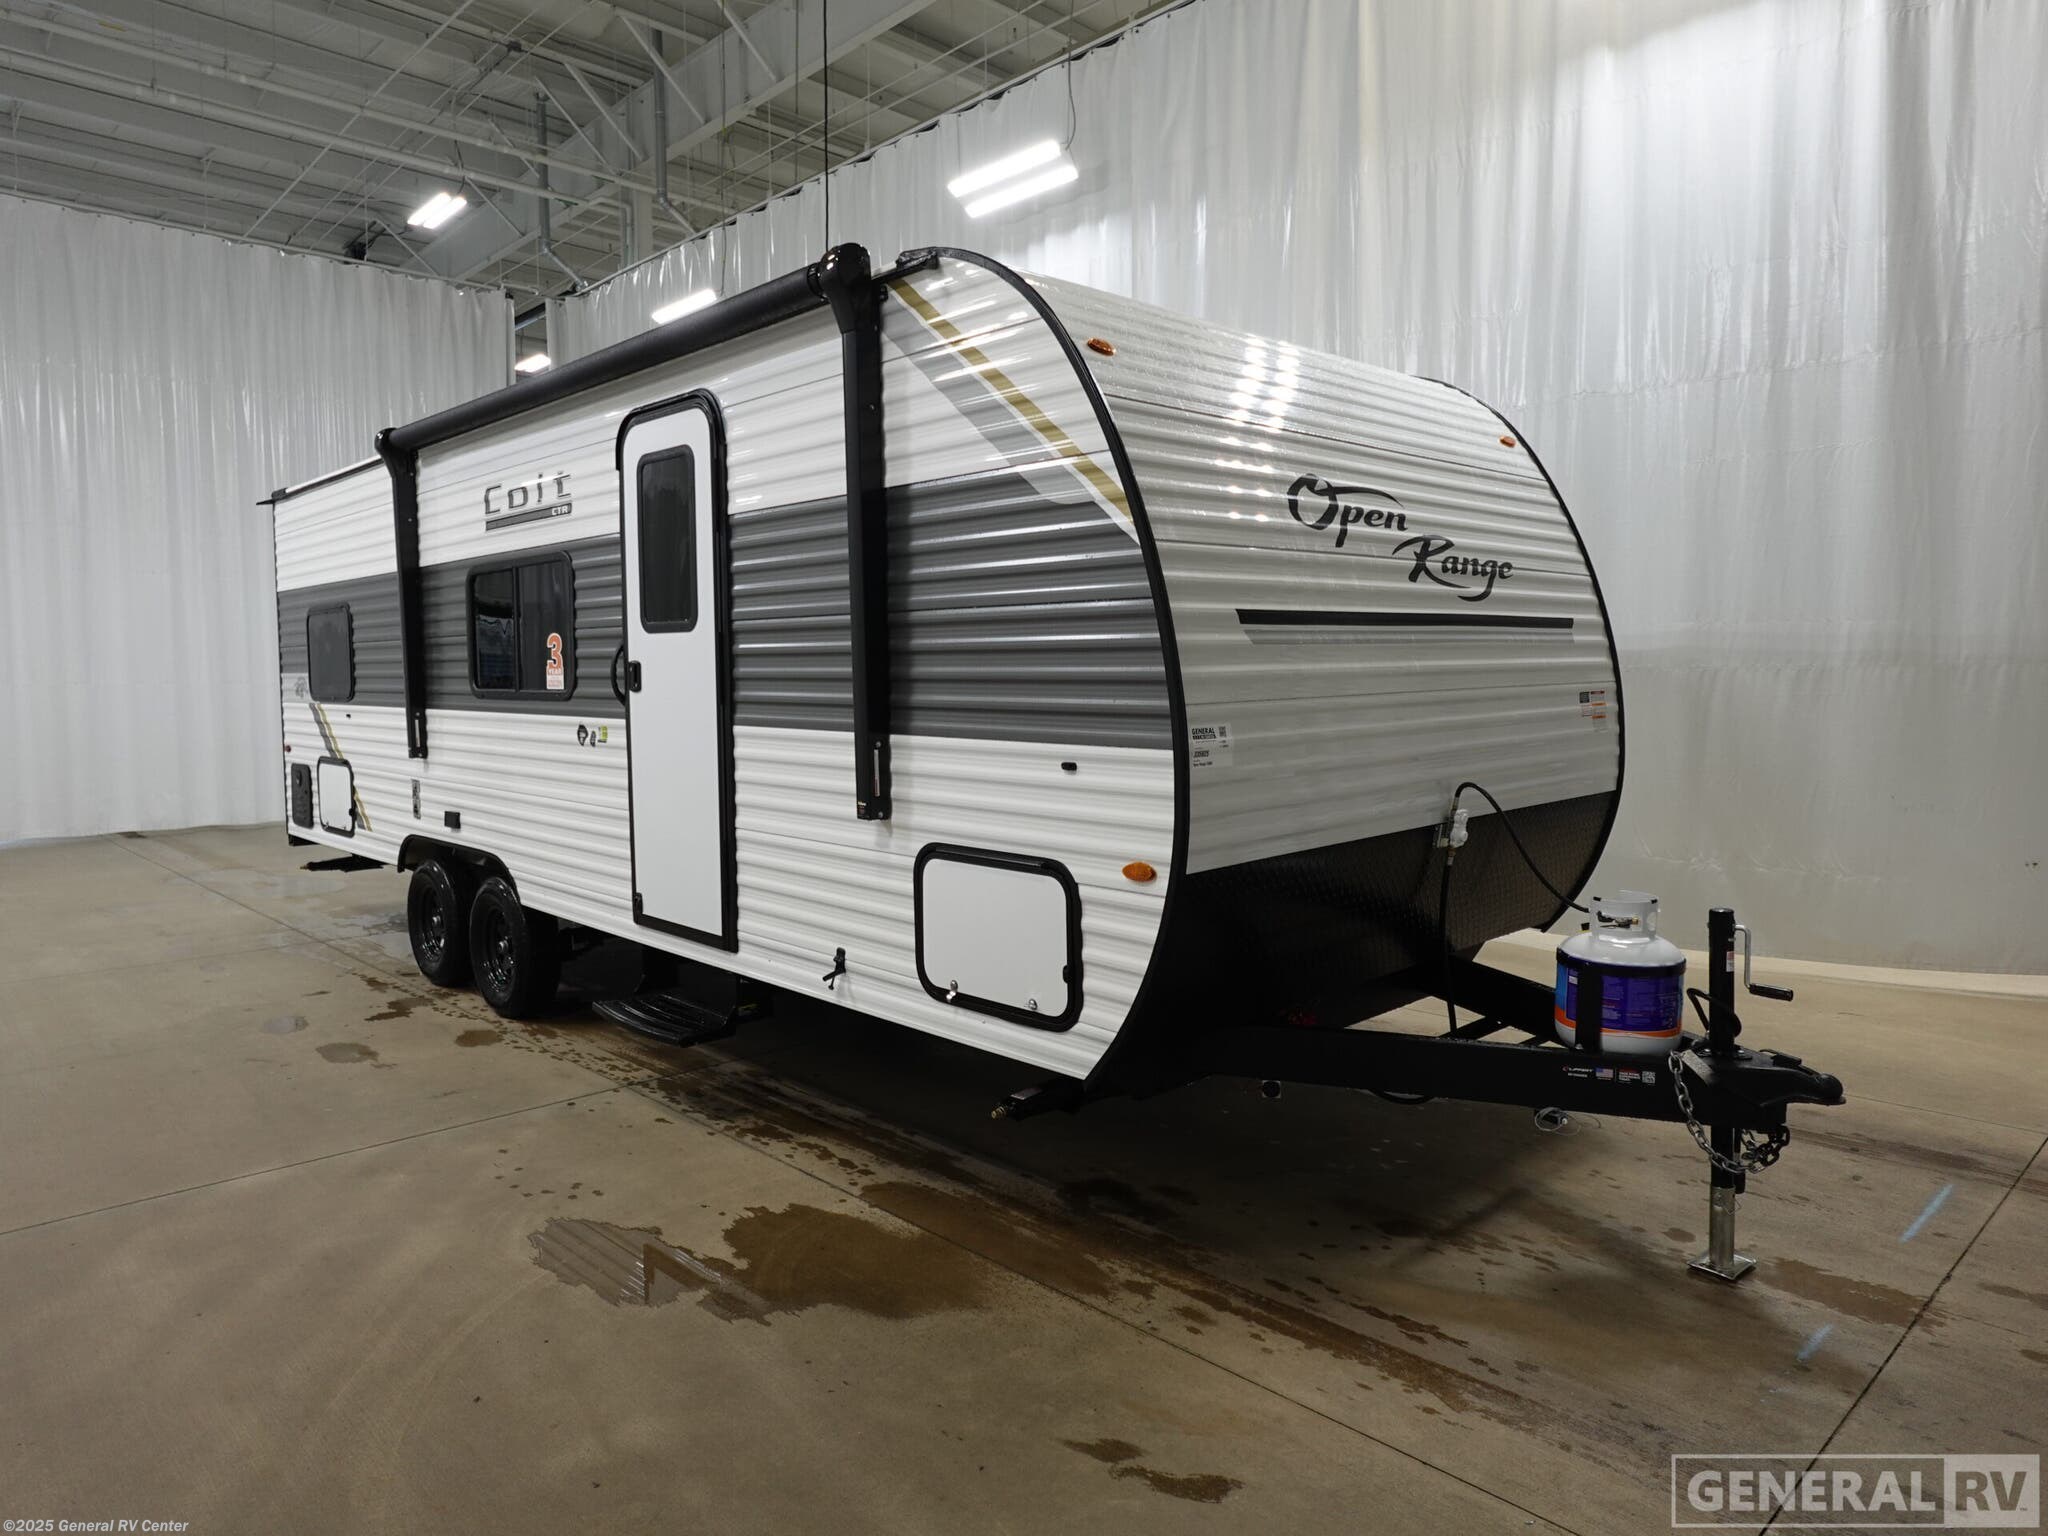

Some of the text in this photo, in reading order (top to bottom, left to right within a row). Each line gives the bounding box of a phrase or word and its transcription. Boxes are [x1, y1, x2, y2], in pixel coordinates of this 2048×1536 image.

[551, 505, 569, 516] CTR
[1287, 473, 1408, 548] Open
[1391, 534, 1514, 602] Range
[546, 632, 564, 668] 3
[1191, 727, 1216, 736] GENERAL
